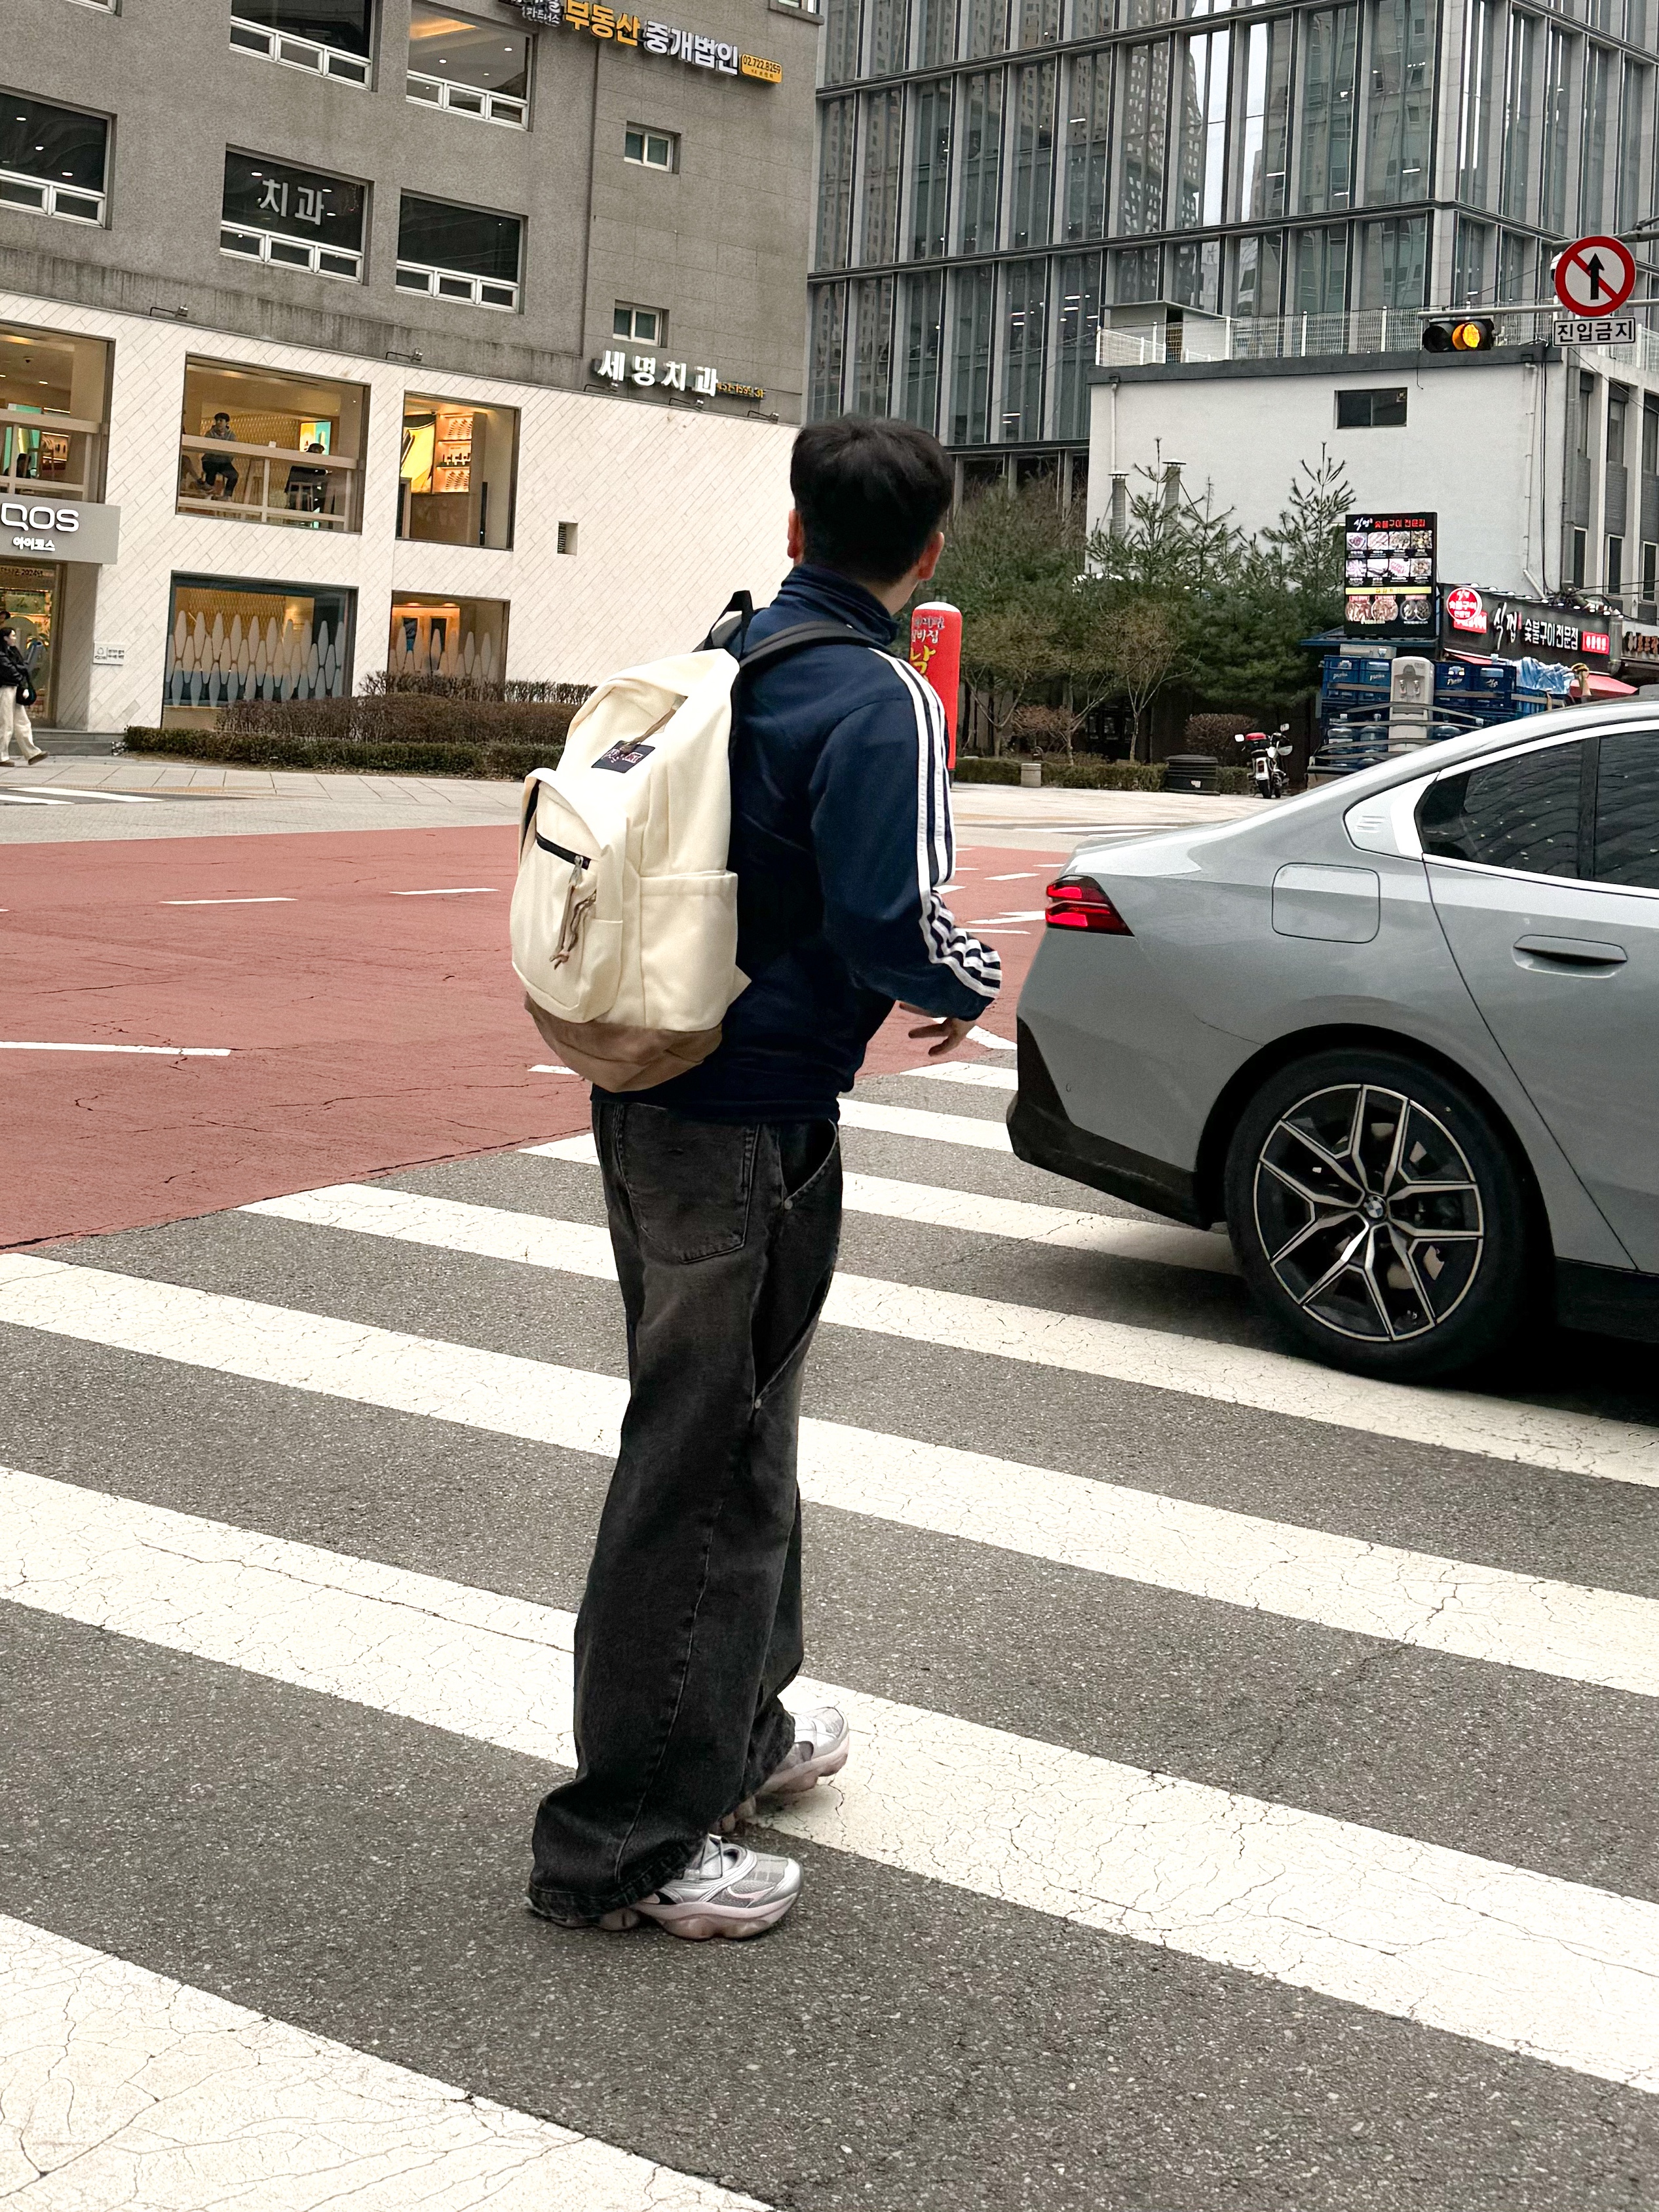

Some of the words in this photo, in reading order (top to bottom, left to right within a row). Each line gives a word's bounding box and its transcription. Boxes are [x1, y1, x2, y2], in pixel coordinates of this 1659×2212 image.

[525, 7, 560, 24] 파트너스
[565, 0, 641, 47] 부동산
[645, 20, 739, 75] 중개법인
[259, 178, 324, 225] 치과
[1557, 320, 1632, 342] 진입금지
[598, 350, 718, 397] 세명치과
[12, 536, 56, 552] 아이코스
